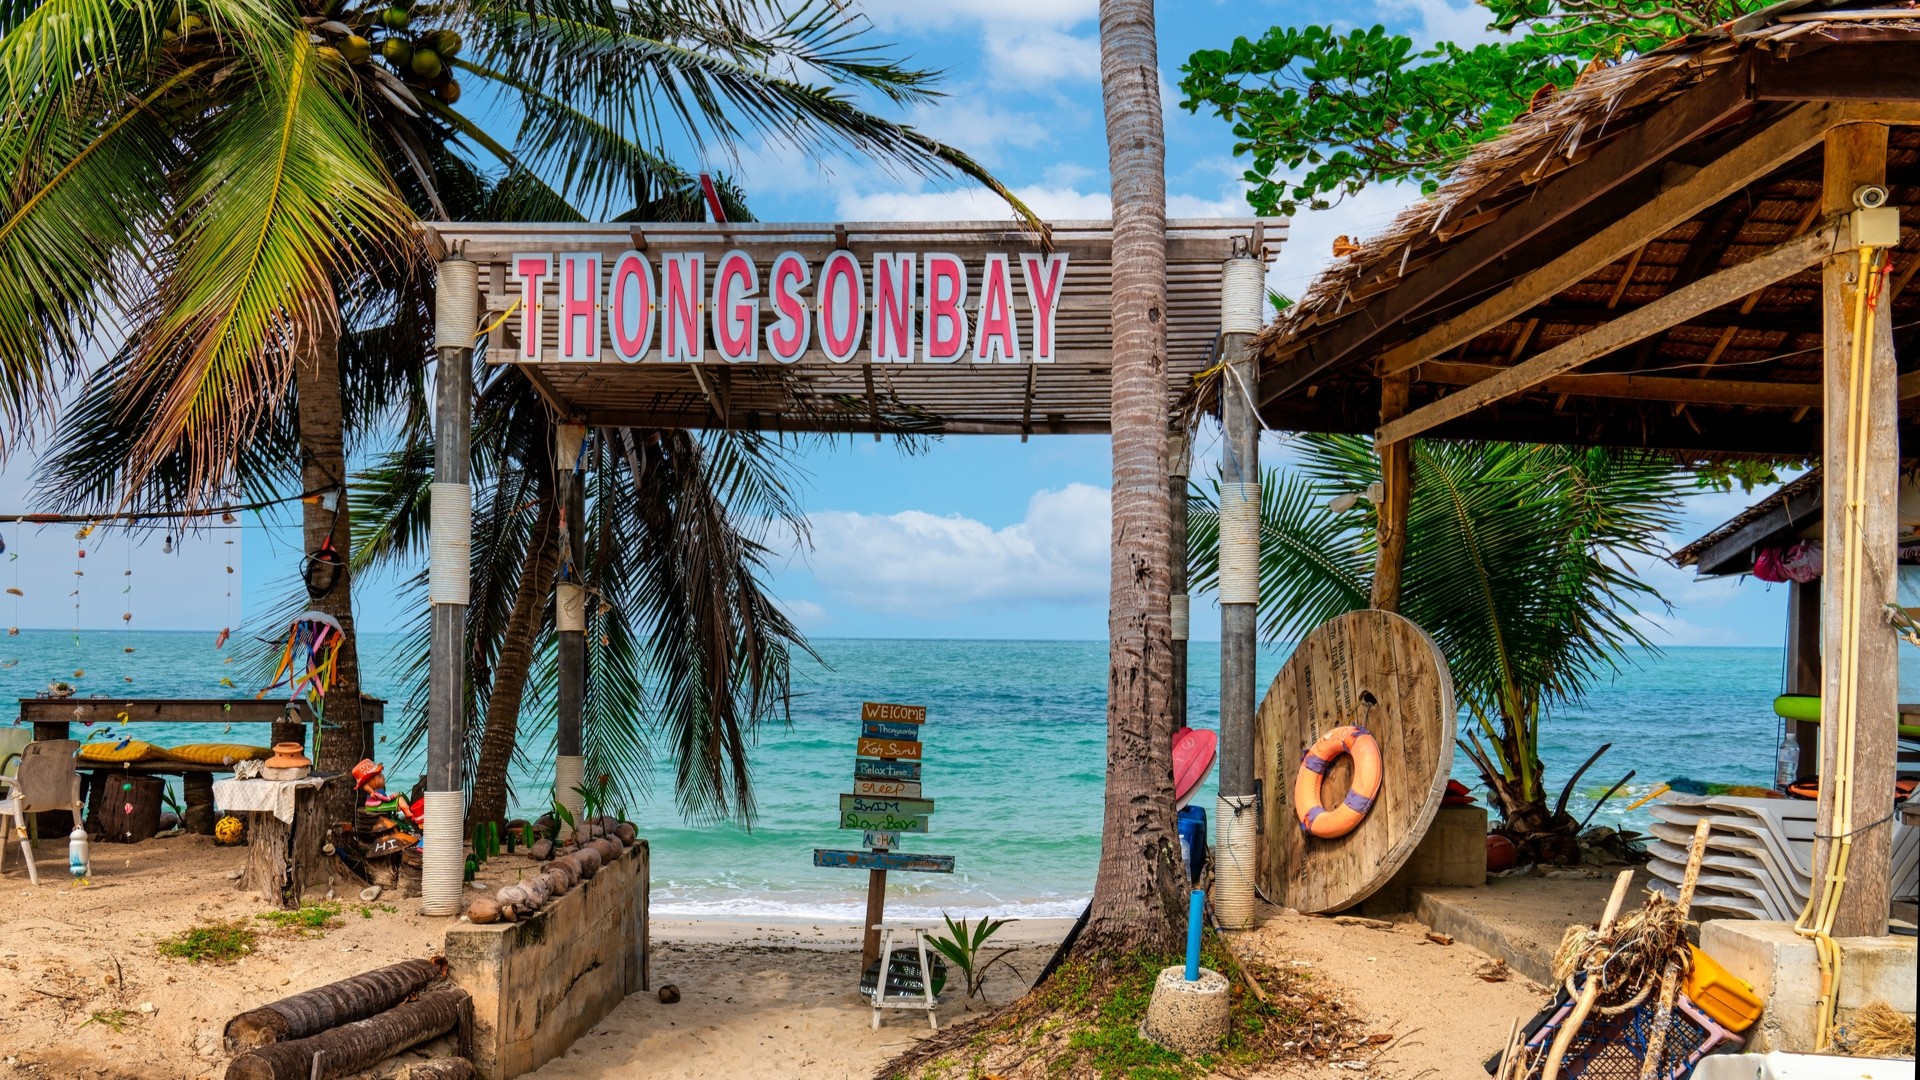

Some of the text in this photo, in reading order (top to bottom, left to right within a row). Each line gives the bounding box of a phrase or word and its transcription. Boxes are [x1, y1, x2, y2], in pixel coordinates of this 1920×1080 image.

[512, 251, 1069, 363] THONGSONBAY
[375, 839, 398, 852] HI
[863, 832, 896, 846] ALOHA
